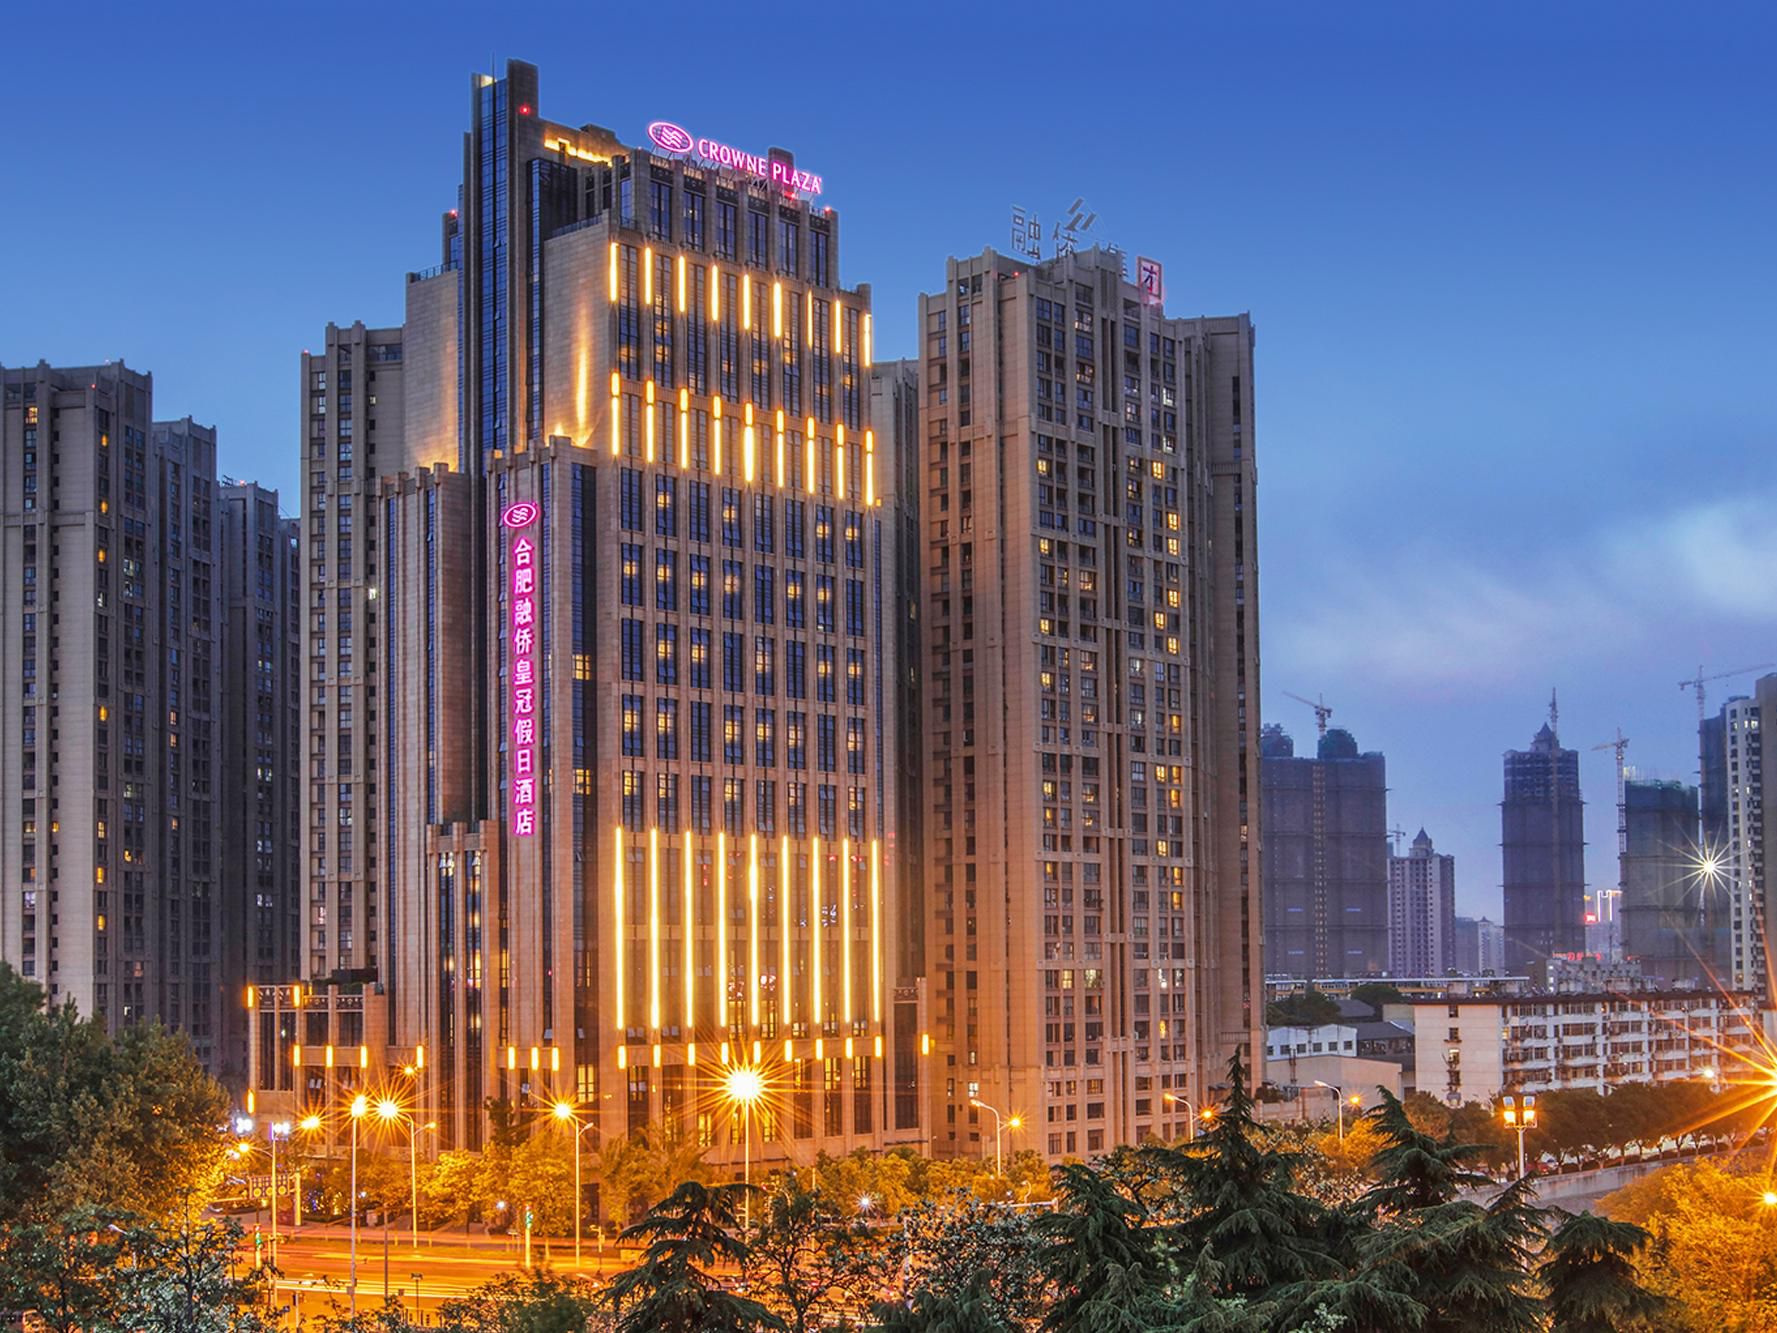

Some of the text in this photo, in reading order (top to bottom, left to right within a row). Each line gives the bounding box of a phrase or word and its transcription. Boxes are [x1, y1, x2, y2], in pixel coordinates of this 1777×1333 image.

[698, 139, 821, 194] CROWNE PLAZA
[514, 538, 534, 835] 合肥融侨皇冠假日酒店
